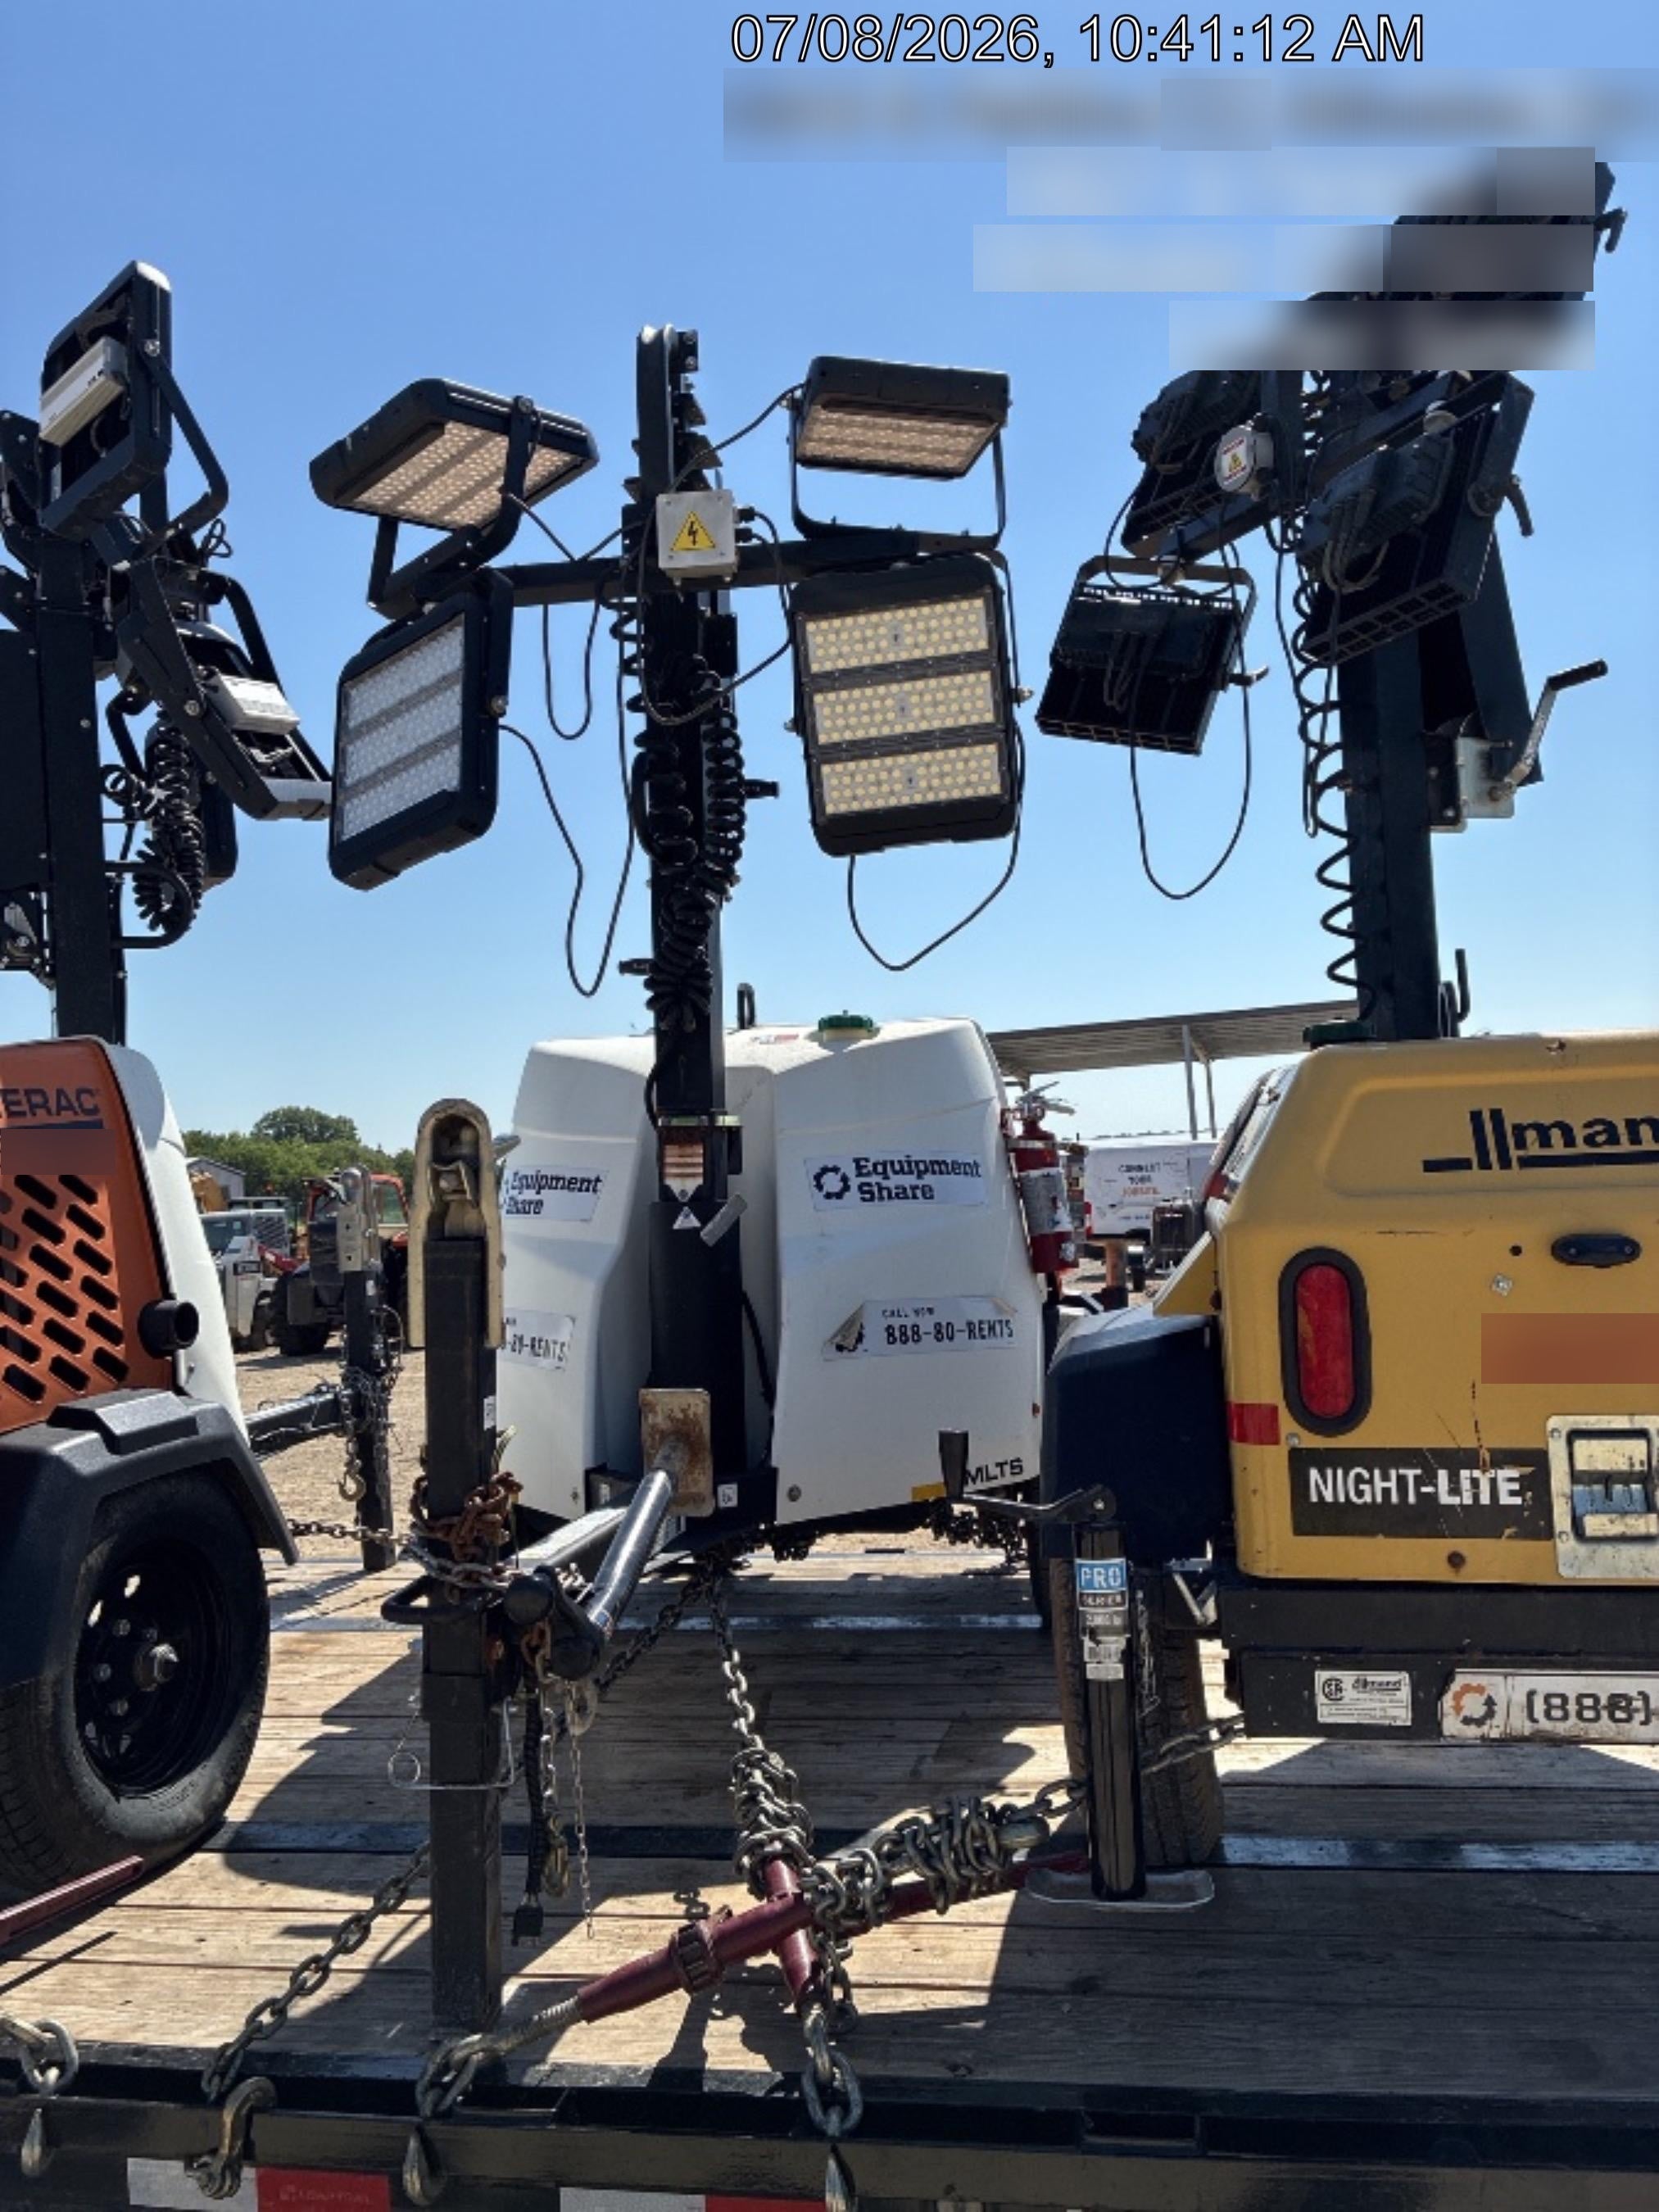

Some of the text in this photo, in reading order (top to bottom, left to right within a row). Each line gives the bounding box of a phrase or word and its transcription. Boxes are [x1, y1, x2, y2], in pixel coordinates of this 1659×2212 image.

[0, 1087, 100, 1118] ERAC
[852, 1155, 982, 1181] Equipment
[857, 1181, 935, 1203] Share
[884, 1319, 1014, 1346] 888-80-RENTS
[1309, 1466, 1523, 1506] NIGHT-LITE
[1081, 1566, 1122, 1588] PRO
[1526, 1688, 1652, 1726] (888)
